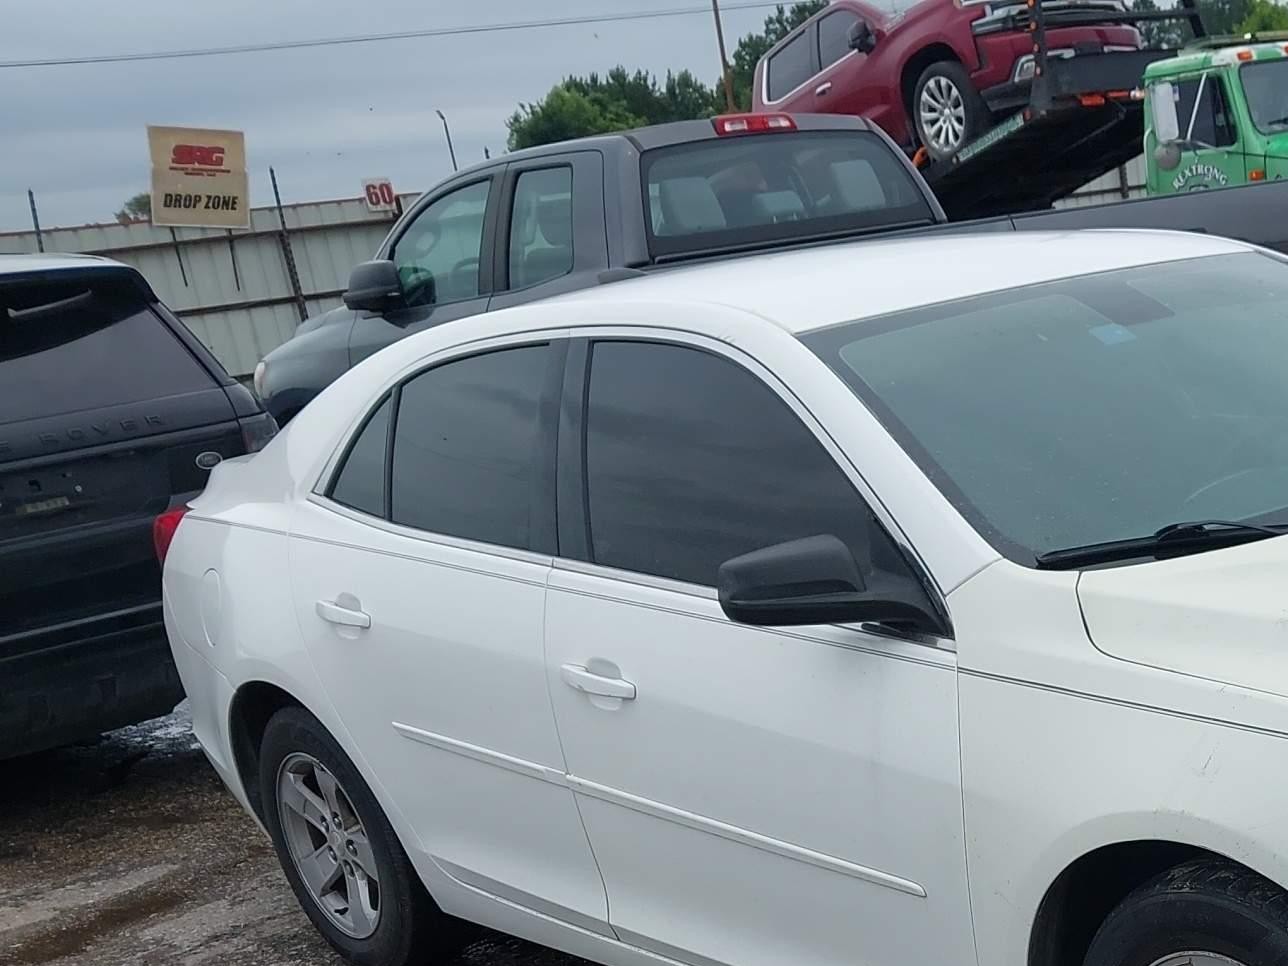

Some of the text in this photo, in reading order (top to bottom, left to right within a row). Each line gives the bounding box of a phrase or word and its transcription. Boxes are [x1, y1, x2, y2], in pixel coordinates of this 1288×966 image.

[163, 193, 239, 211] DROP ZONE
[365, 183, 394, 206] 60
[38, 415, 163, 444] ROVER
